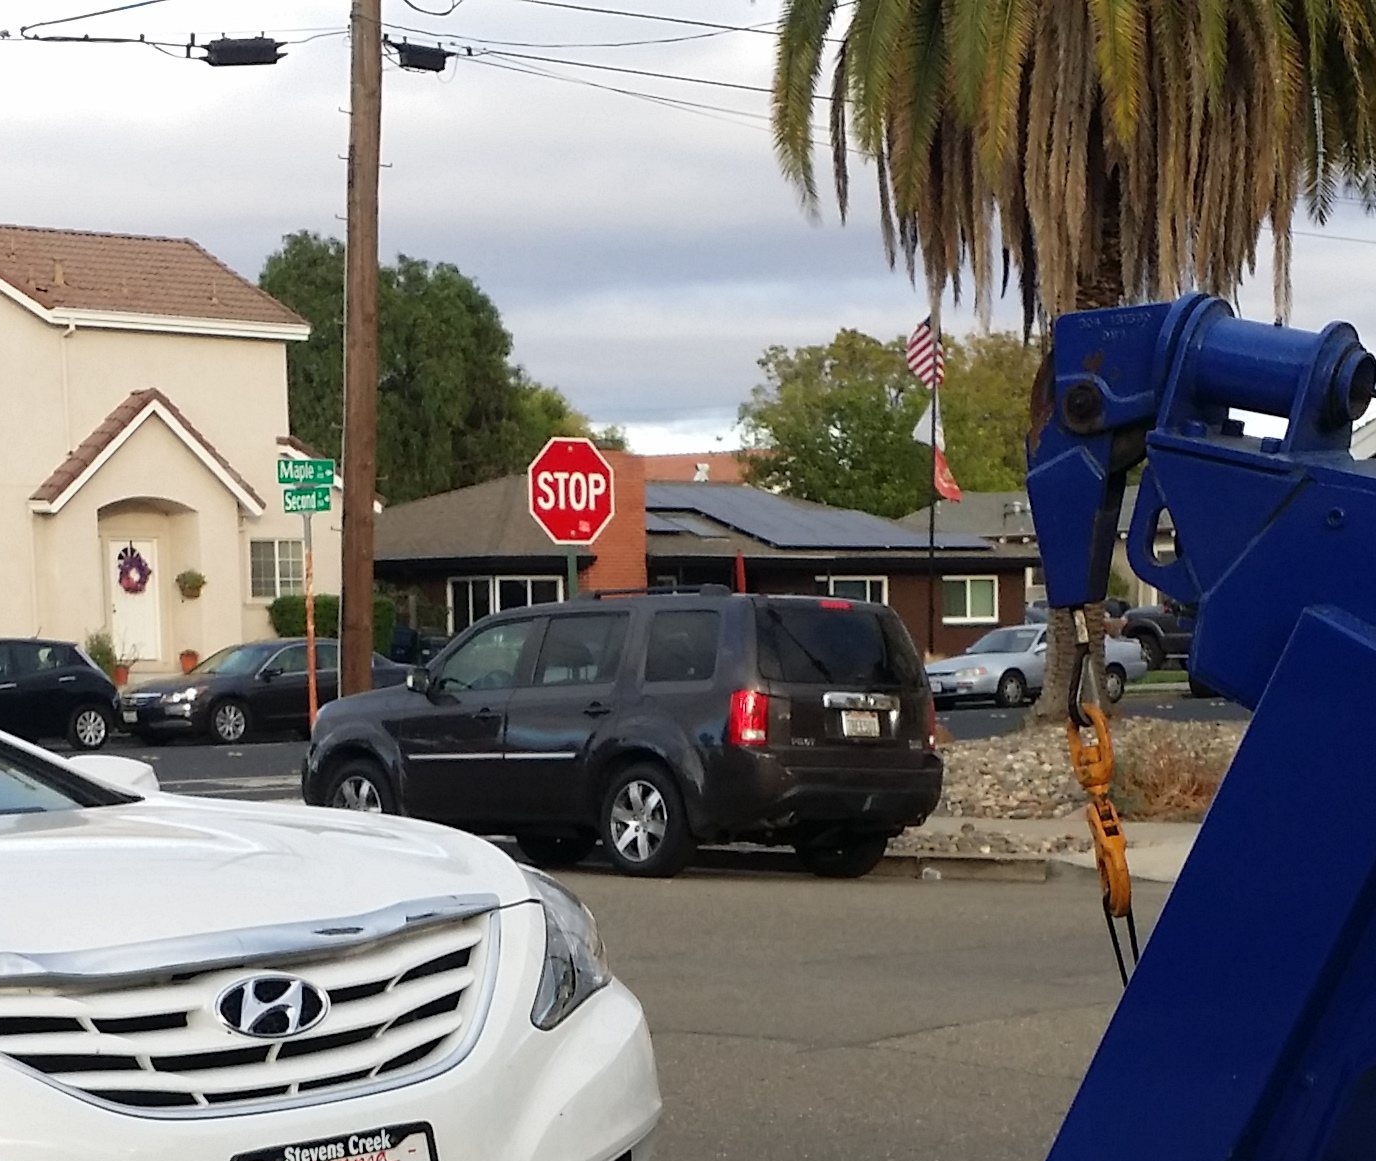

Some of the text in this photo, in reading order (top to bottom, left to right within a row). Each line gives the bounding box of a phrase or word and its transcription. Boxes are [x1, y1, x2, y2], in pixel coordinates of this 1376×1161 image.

[279, 461, 314, 482] Maple
[285, 491, 316, 510] Second
[537, 471, 606, 511] STOP
[348, 1128, 392, 1155] Creek
